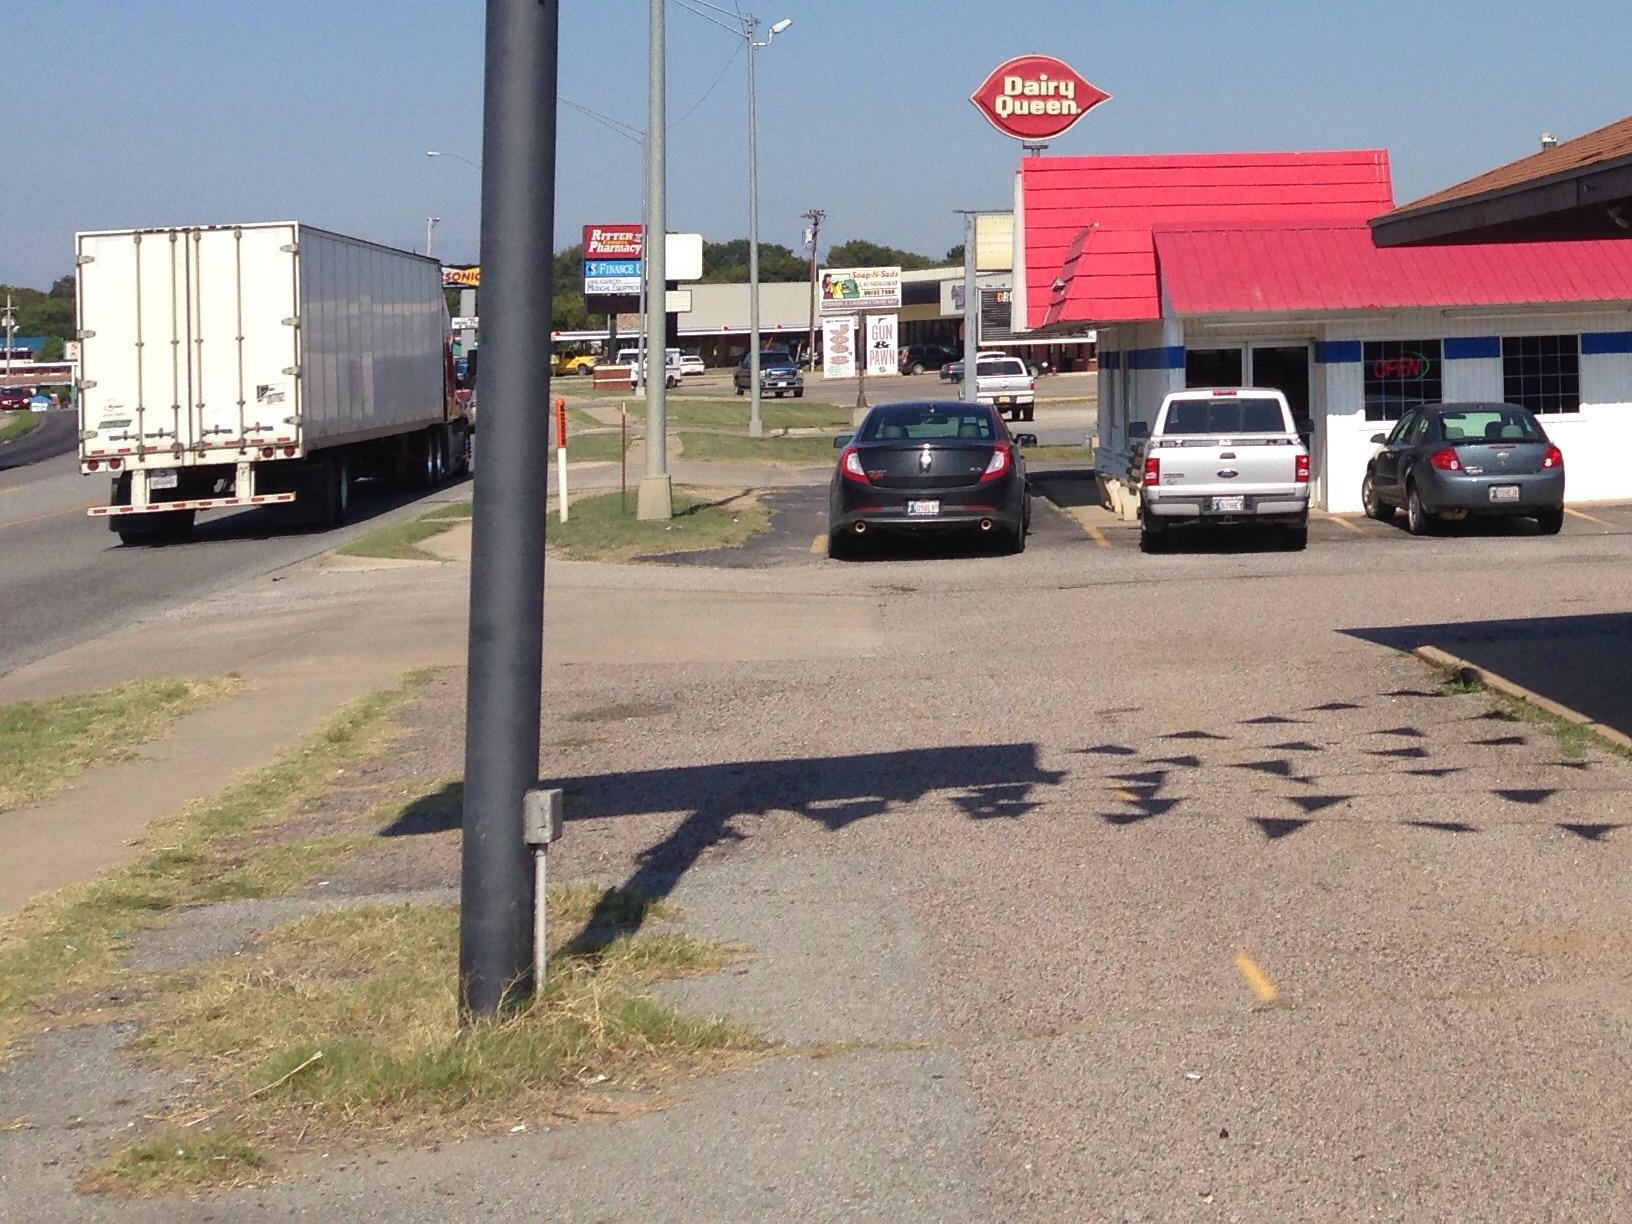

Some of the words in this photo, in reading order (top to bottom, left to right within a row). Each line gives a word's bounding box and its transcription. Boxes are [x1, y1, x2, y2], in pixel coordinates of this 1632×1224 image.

[1003, 73, 1076, 99] Dairy
[994, 94, 1078, 118] Queen
[588, 240, 642, 254] Pharmacy
[444, 272, 480, 281] SONIC
[599, 264, 633, 274] FINANCE
[872, 325, 893, 340] GUN
[870, 349, 896, 366] PAWN
